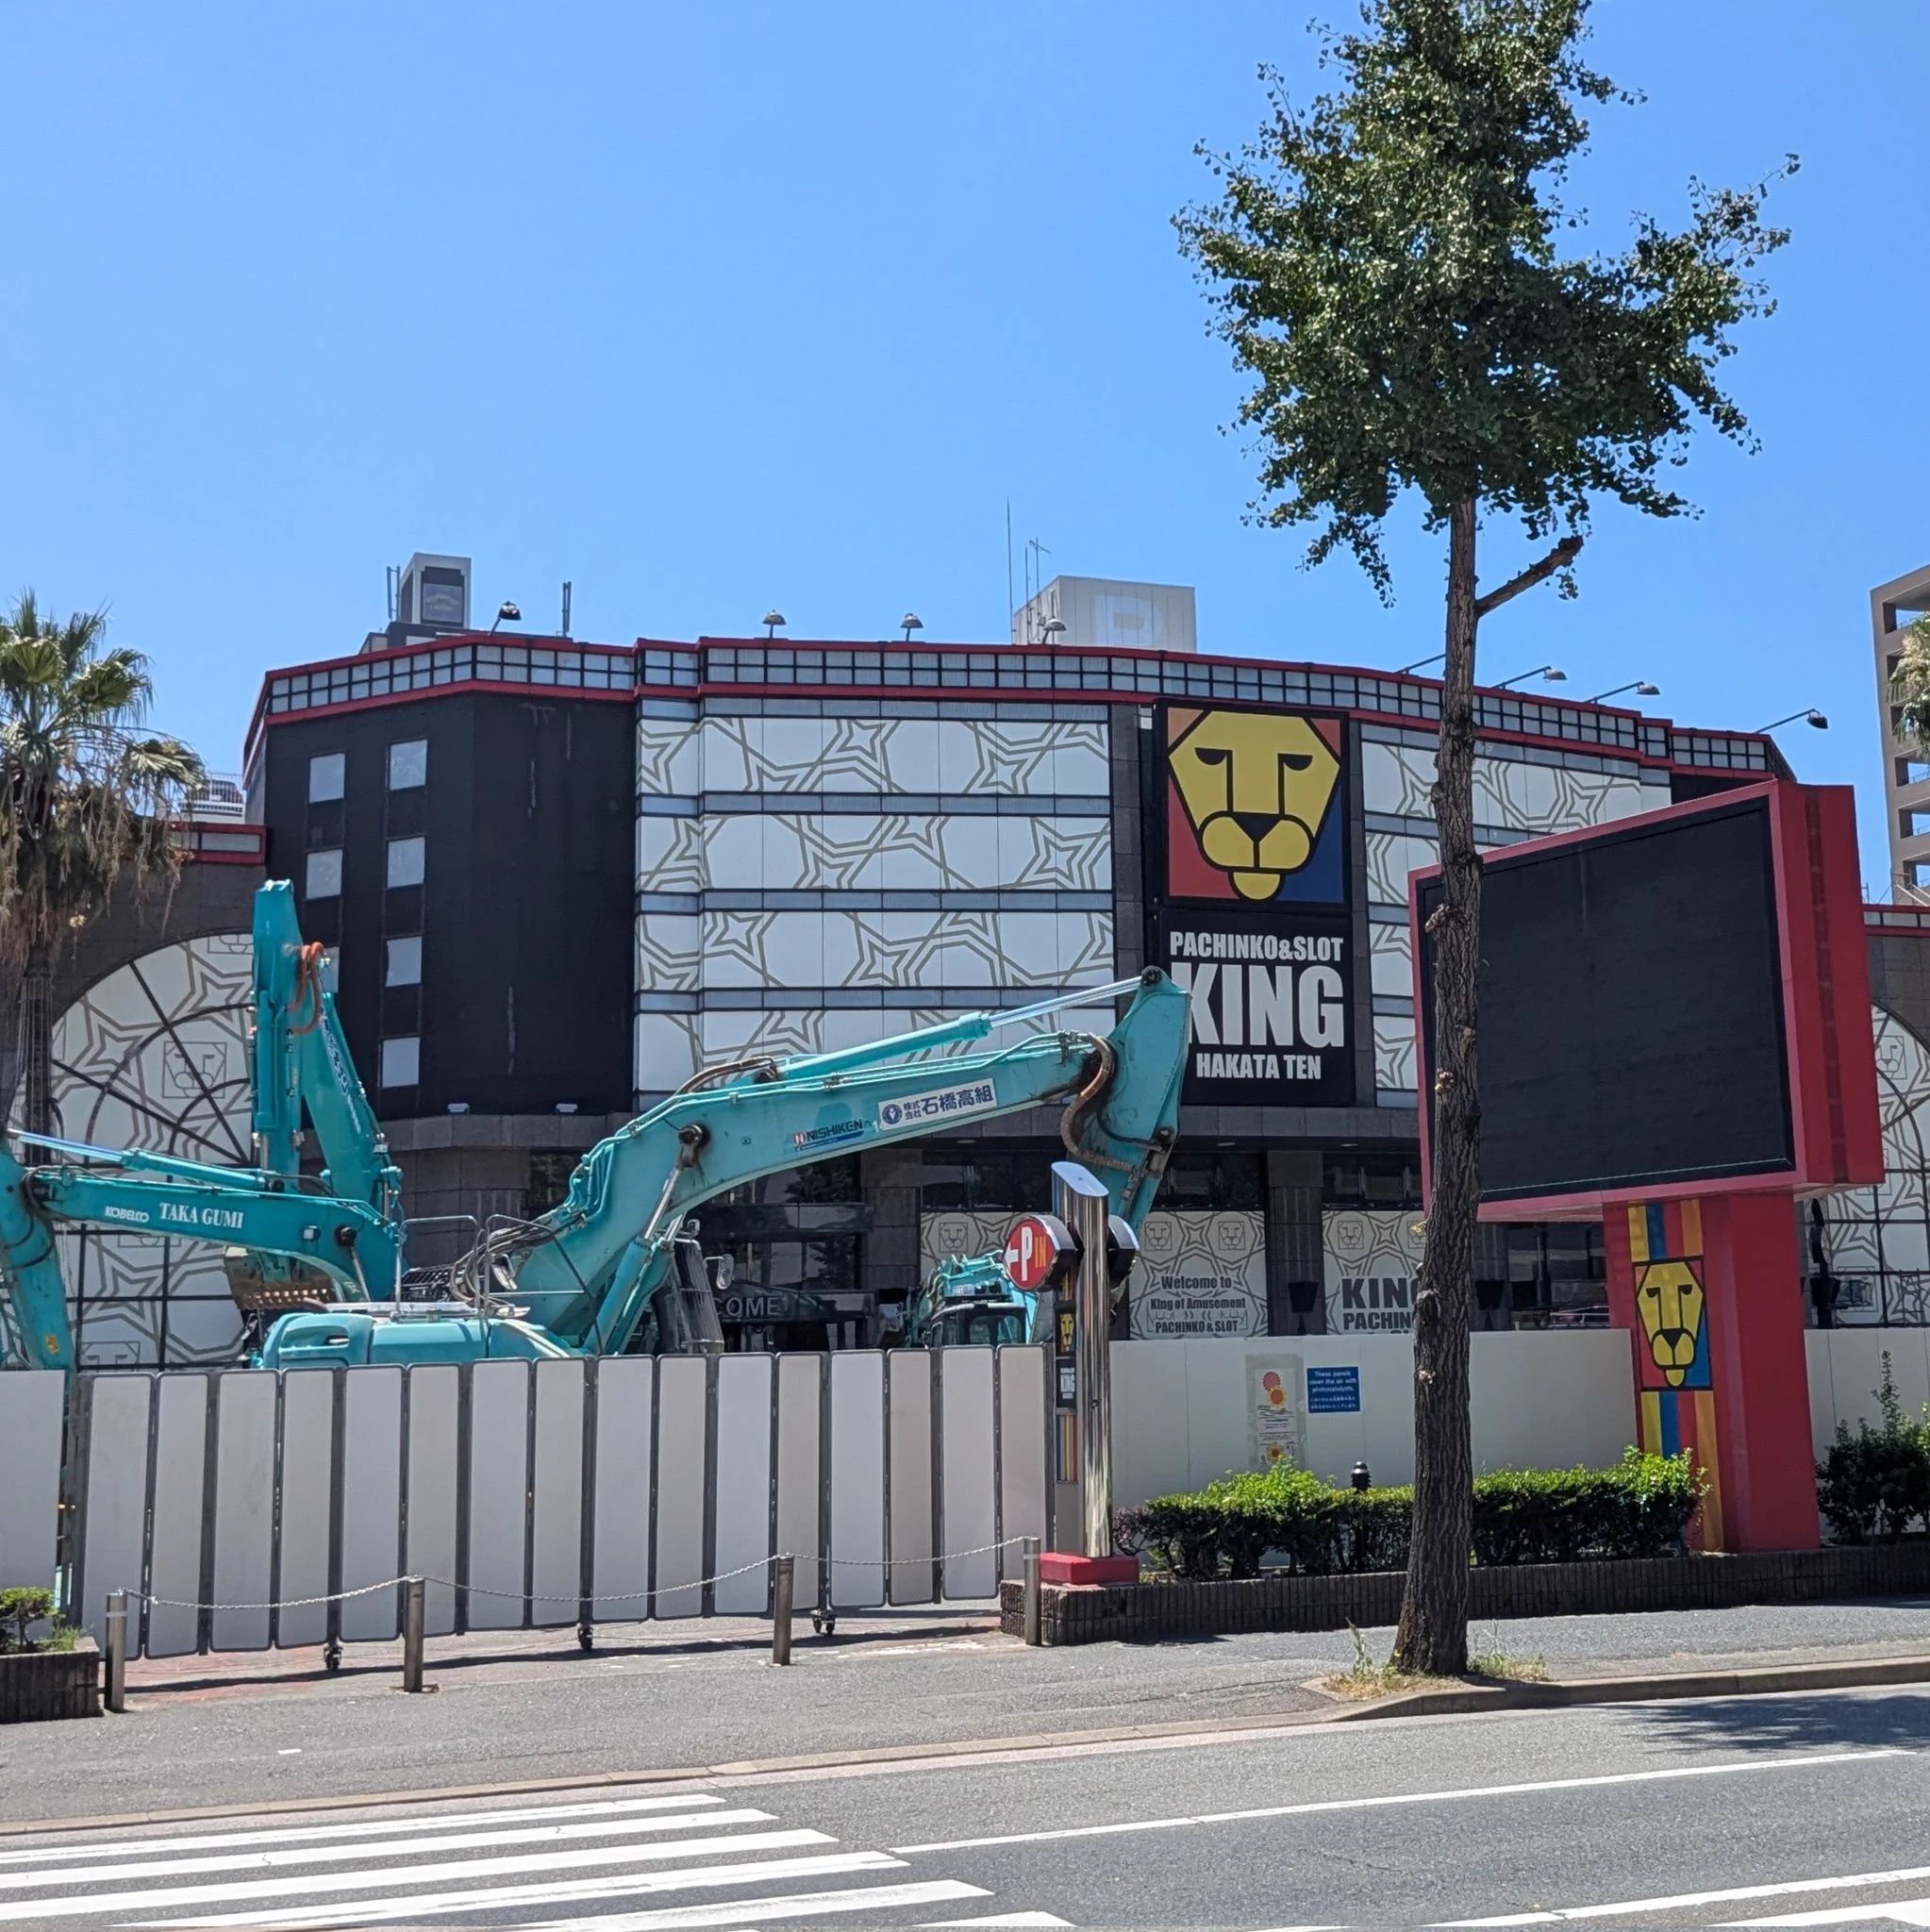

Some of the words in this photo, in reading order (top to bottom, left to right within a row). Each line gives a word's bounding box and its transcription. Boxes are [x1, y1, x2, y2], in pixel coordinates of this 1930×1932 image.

[1170, 931, 1344, 962] PACHINKO&SLOT
[1171, 961, 1344, 1048] KING
[1196, 1053, 1280, 1079] HAKATA
[1284, 1055, 1322, 1080] TEN
[806, 1119, 864, 1141] NISHIKEN
[105, 1206, 150, 1224] KOBELCO
[159, 1202, 199, 1224] TAKA
[202, 1208, 245, 1229] GUMI
[1022, 1226, 1033, 1282] P
[1035, 1234, 1047, 1269] IN
[1161, 1275, 1218, 1290] Welcome
[1220, 1276, 1232, 1290] to
[1150, 1298, 1173, 1310] King
[1174, 1298, 1186, 1309] of
[1187, 1297, 1246, 1309] Amusement
[1155, 1321, 1206, 1334] PACHINKO
[1206, 1323, 1213, 1332] &
[1214, 1321, 1239, 1332] SLOT
